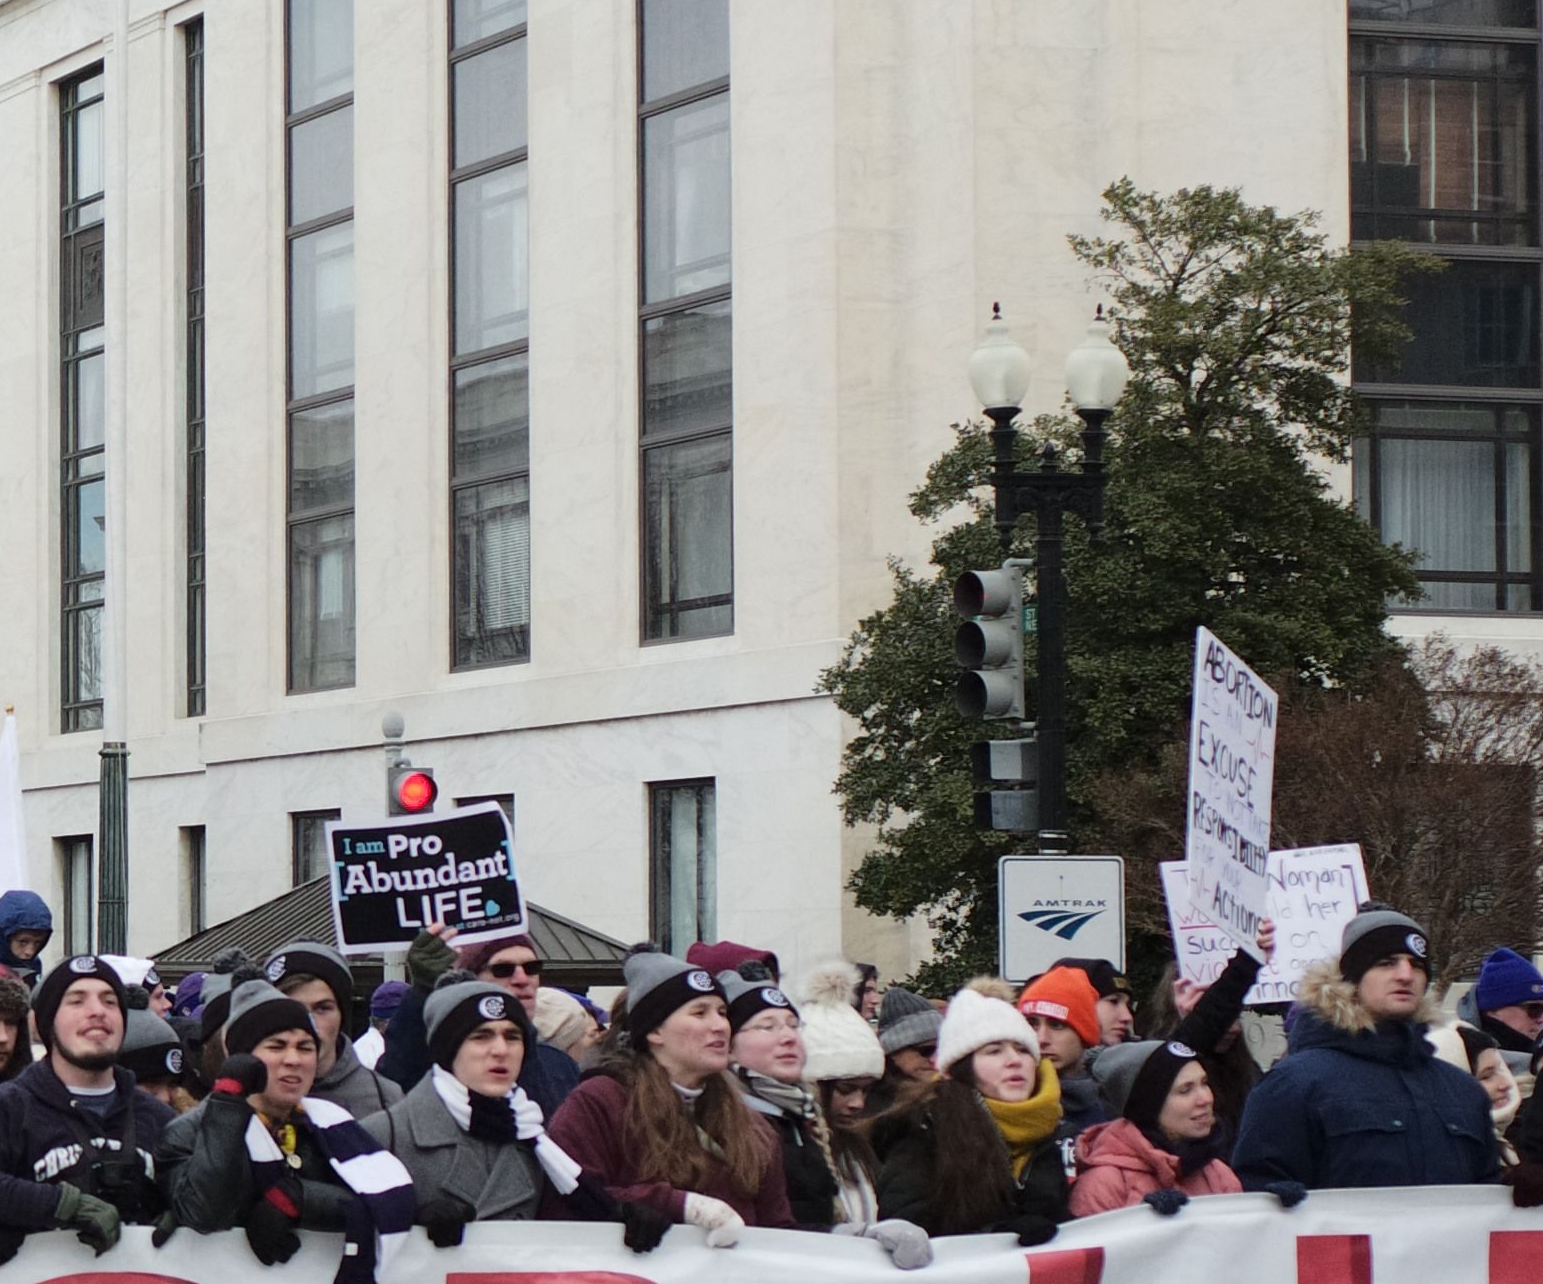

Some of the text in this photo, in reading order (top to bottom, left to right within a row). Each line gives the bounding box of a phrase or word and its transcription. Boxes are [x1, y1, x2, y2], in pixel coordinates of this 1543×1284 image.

[1203, 640, 1273, 729] ABORTION
[1197, 719, 1258, 810] EXCUSE
[343, 834, 443, 859] I am Pro
[396, 886, 485, 928] LIFE
[1033, 899, 1108, 907] AMTRAK
